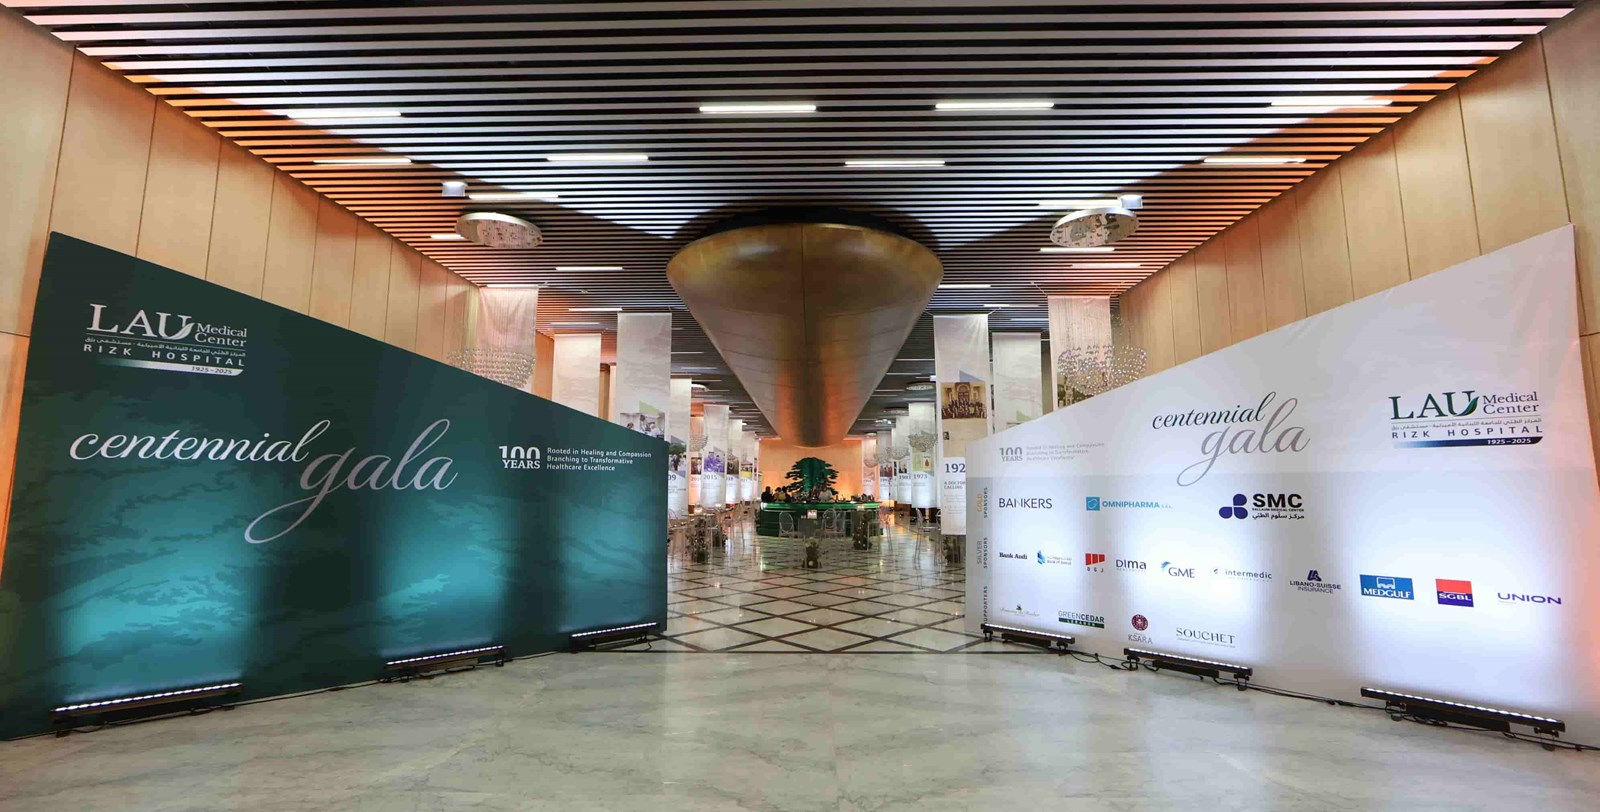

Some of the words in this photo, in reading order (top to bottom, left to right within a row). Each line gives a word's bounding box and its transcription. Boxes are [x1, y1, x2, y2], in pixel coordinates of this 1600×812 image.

[86, 303, 195, 340] LAU
[196, 323, 247, 338] Medical
[195, 332, 247, 347] Center
[83, 344, 131, 356] RIZK
[152, 351, 245, 366] HOSPITAL
[1483, 391, 1538, 405] Medical
[1152, 391, 1277, 430] centennial
[1388, 390, 1480, 420] LAU
[1483, 403, 1540, 415] Center
[1392, 430, 1430, 439] RIZK
[1448, 425, 1543, 437] HOSPITAL
[69, 420, 331, 463] centennial
[1176, 397, 1311, 487] gala
[499, 445, 541, 460] 100
[547, 447, 571, 455] Rooted
[581, 448, 604, 457] Healing
[606, 449, 617, 457] and
[618, 450, 652, 458] Compassion
[999, 446, 1023, 456] 100
[502, 459, 541, 469] YEARS
[547, 455, 580, 464] Branching
[590, 456, 633, 465] Transformative
[547, 463, 582, 471] Healthcare
[584, 464, 616, 472] Excellence
[944, 463, 967, 473] 192
[244, 418, 459, 544] gala
[999, 497, 1053, 509] BANKERS
[1102, 500, 1160, 509] OMNIPHARMA
[1252, 493, 1303, 508] SMC
[1168, 566, 1196, 579] GME
[1225, 568, 1272, 580] intermedic
[1289, 580, 1341, 590] LIBANO-SUISSE
[1297, 586, 1334, 594] INSURANCE
[1363, 588, 1411, 599] MEDGULF
[1438, 592, 1470, 601] SGBL
[1497, 592, 1562, 605] UNION
[1058, 610, 1105, 623] GREENCEDAR
[1128, 633, 1153, 644] KSARA
[1175, 627, 1236, 645] SOUCHET
